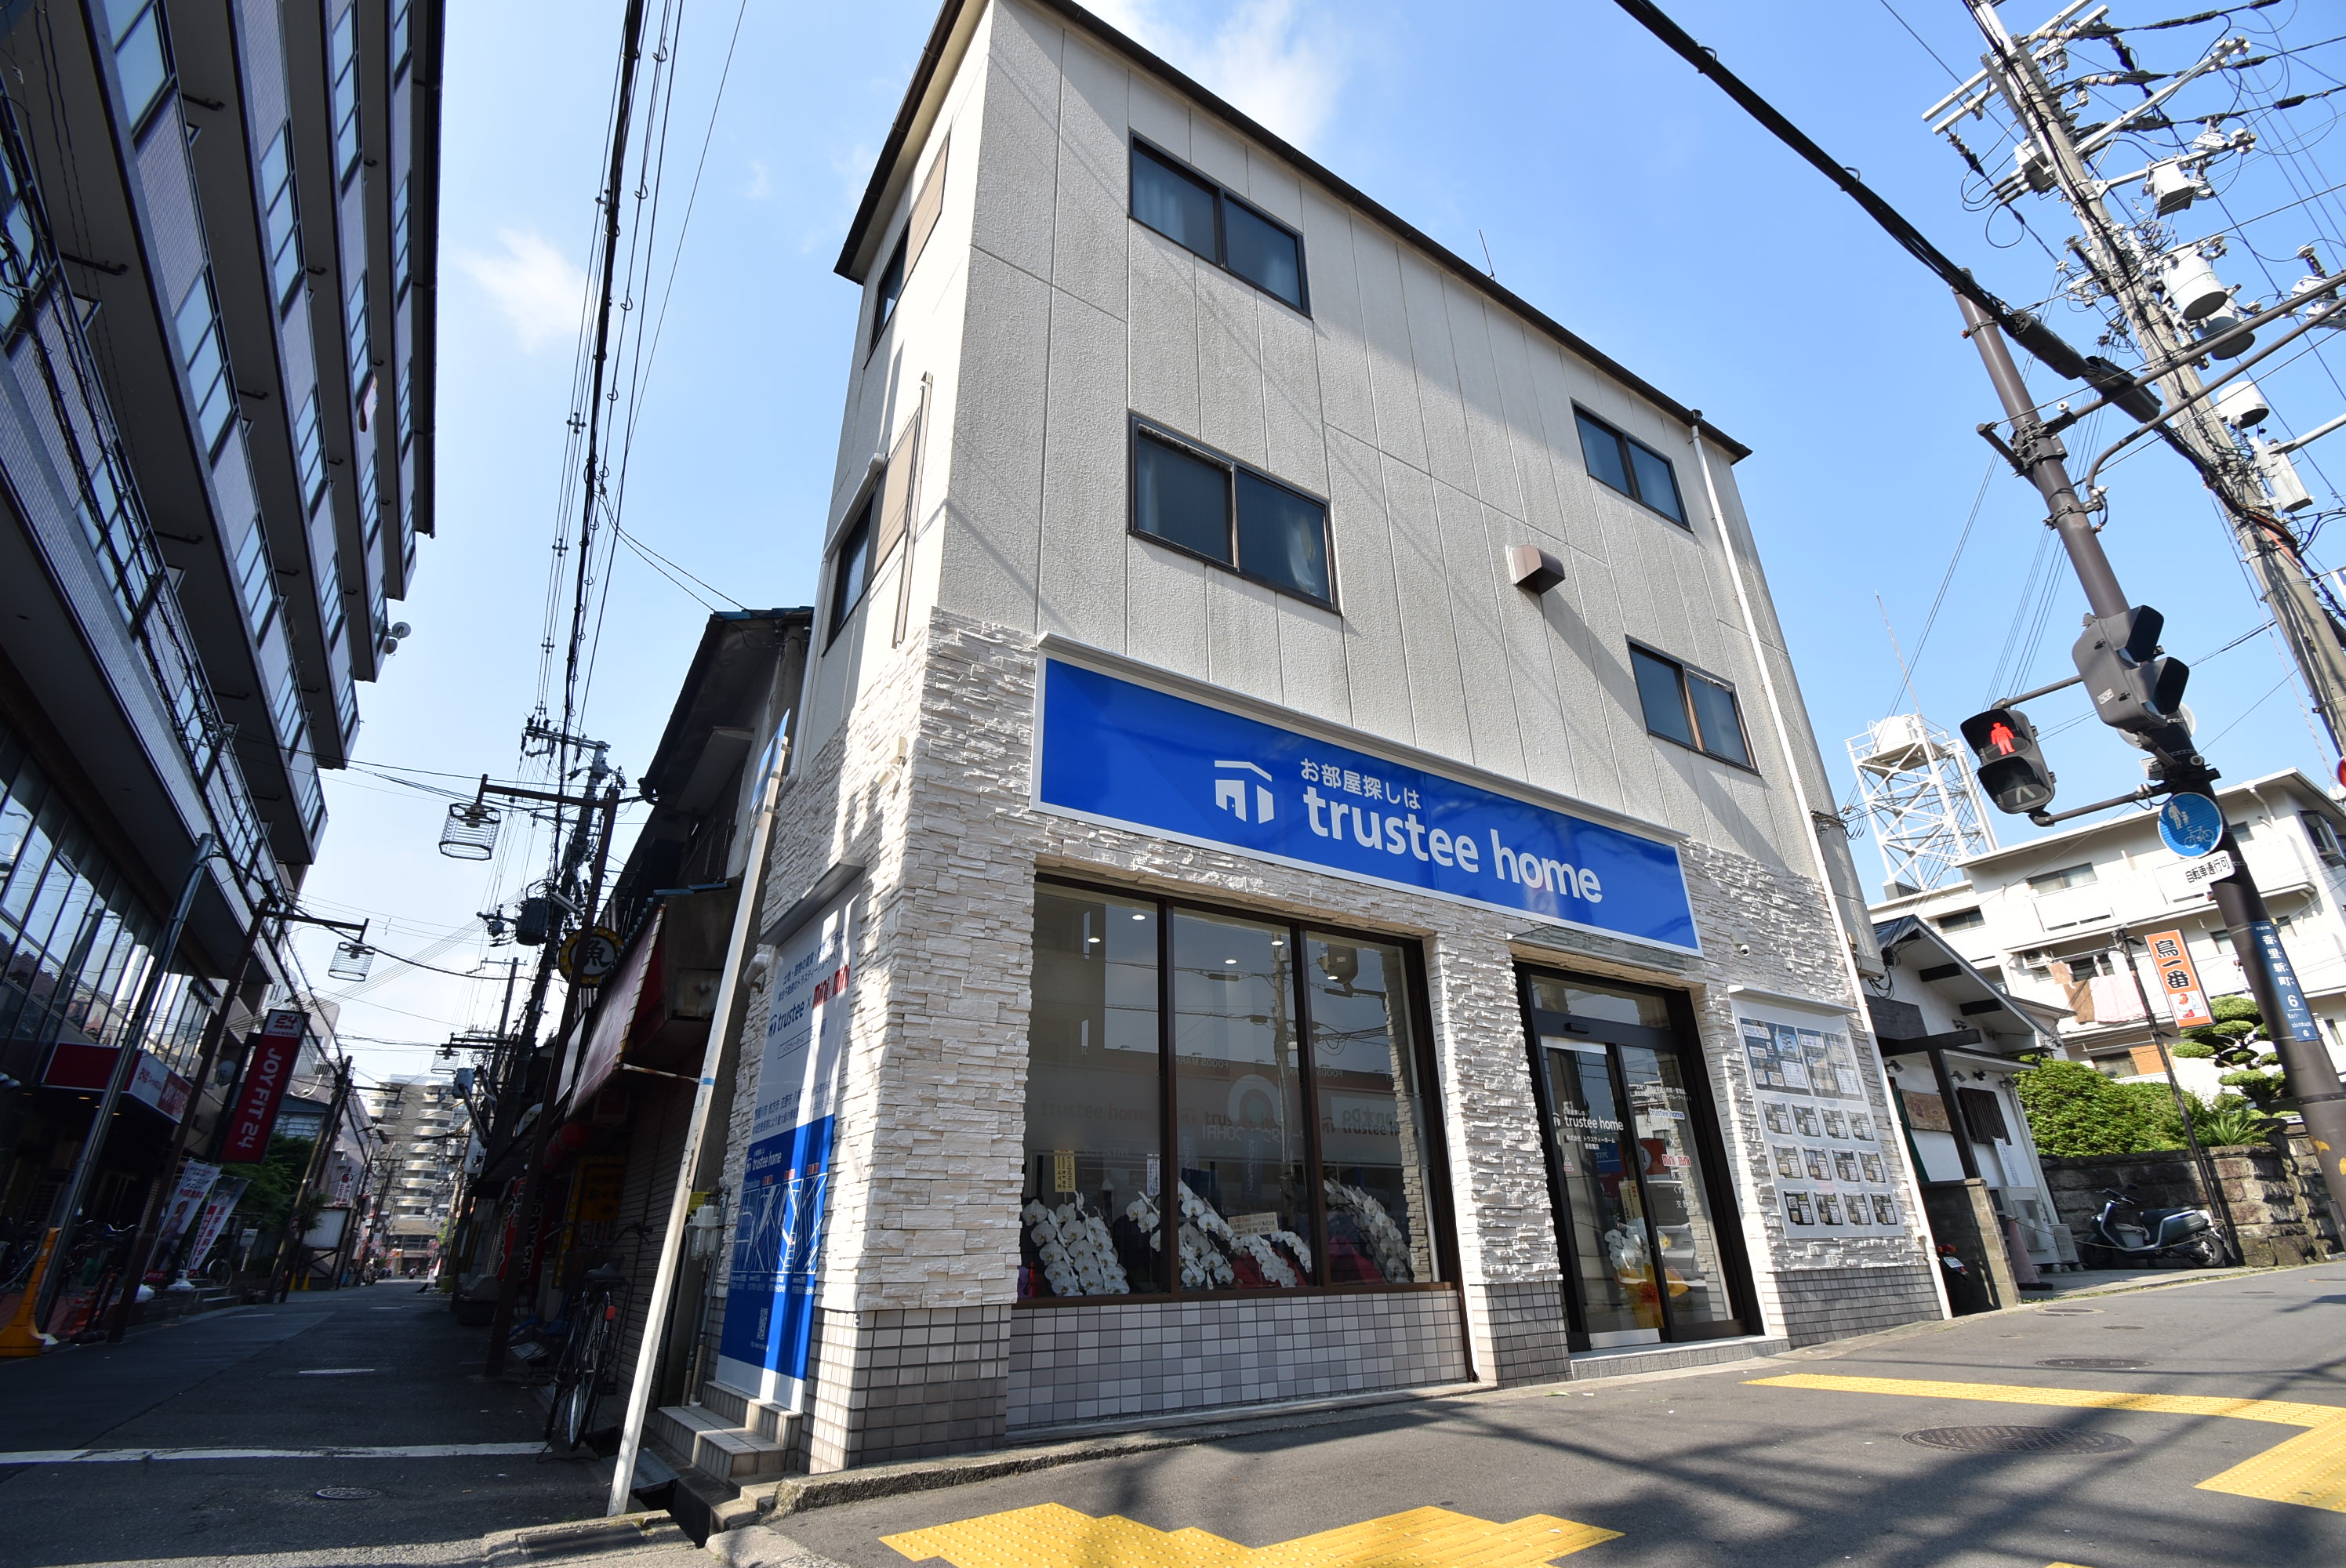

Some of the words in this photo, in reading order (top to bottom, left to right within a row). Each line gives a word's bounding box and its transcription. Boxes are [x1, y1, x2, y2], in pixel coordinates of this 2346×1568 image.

[1300, 757, 1422, 811] お部屋探しは
[1302, 786, 1478, 874] trustee
[1491, 828, 1603, 903] home
[2185, 856, 2230, 883] 自転車通行可
[2154, 940, 2189, 989] 鳥一番
[2261, 935, 2293, 987] 香里新町
[2287, 994, 2299, 1007] 6
[777, 1001, 804, 1034] trustee
[812, 978, 830, 1011] mini
[832, 962, 852, 998] mini
[275, 1014, 298, 1025] 24
[259, 1047, 283, 1088] JOY
[248, 1087, 271, 1120] FIT
[1041, 1100, 1104, 1120] trustee
[1649, 1108, 1669, 1117] trustee
[1669, 1109, 1684, 1119] home
[237, 1121, 260, 1149] 24
[1342, 1120, 1387, 1136] trustee
[1564, 1116, 1597, 1129] trustee
[1599, 1116, 1624, 1131] home
[752, 1156, 768, 1171] trustee
[768, 1150, 782, 1166] home
[1662, 1155, 1676, 1166] mini
[1677, 1156, 1691, 1167] mini
